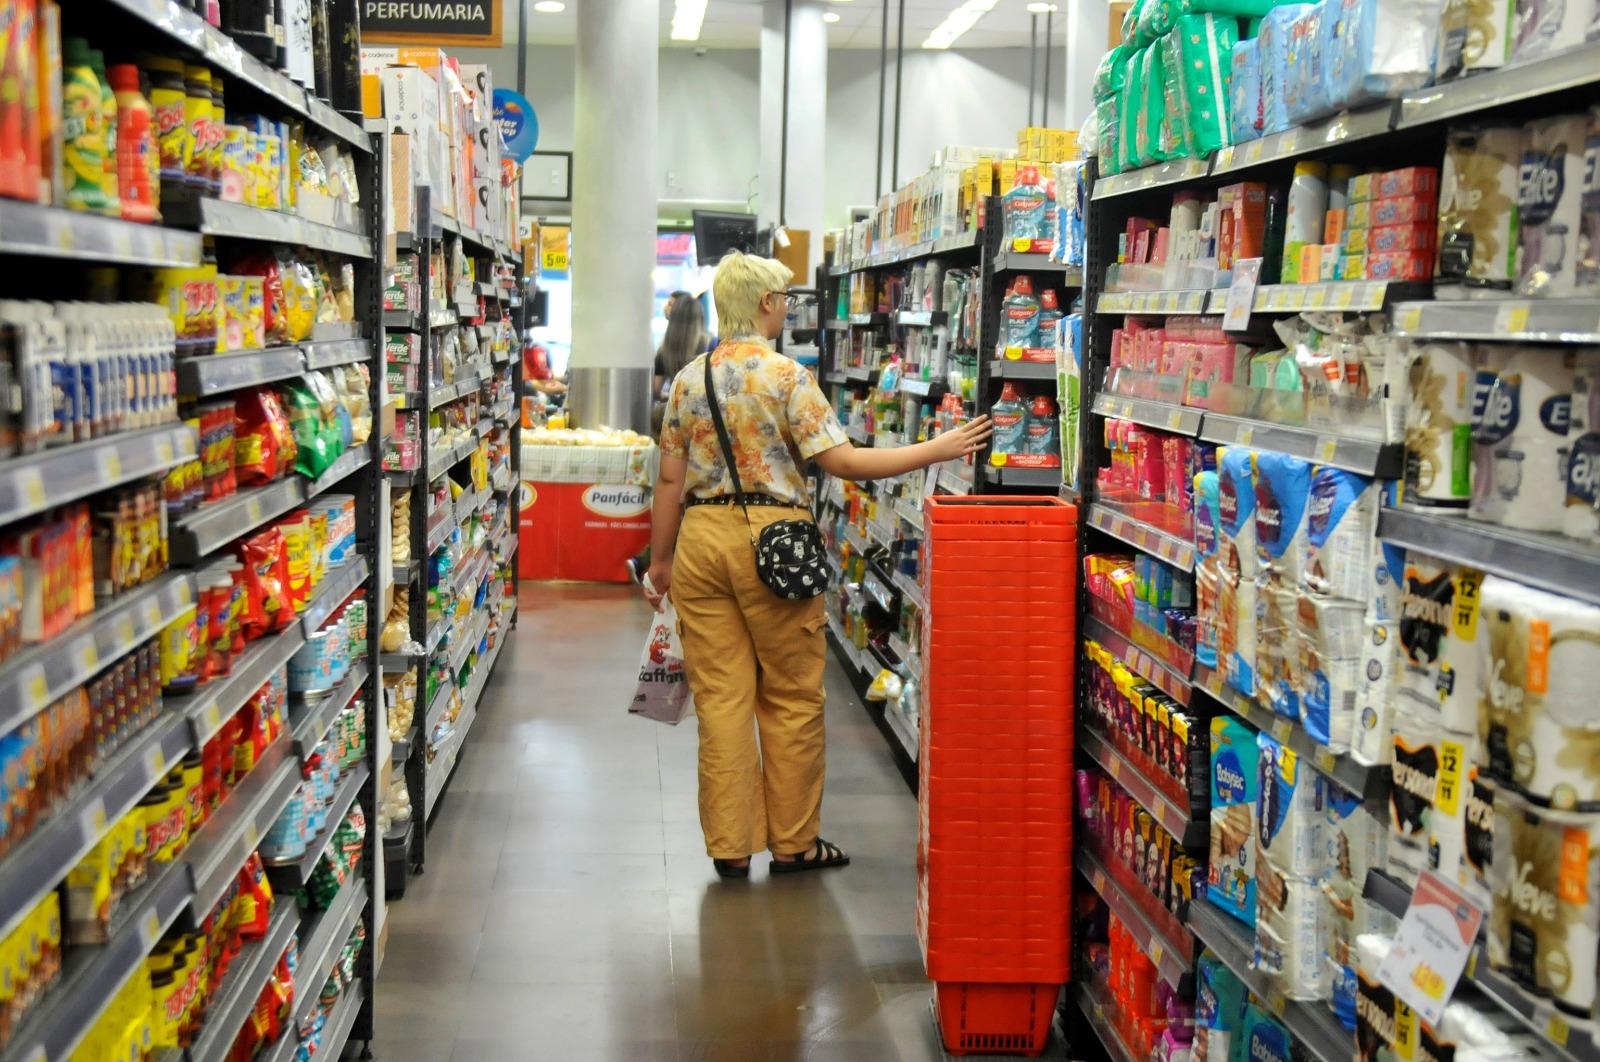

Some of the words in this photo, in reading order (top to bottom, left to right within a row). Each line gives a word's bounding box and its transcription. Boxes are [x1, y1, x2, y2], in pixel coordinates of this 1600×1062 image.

[366, 2, 486, 21] PERFUMARIA
[393, 263, 413, 273] erde
[385, 373, 405, 382] erde
[591, 491, 646, 506] Panfácil
[1460, 579, 1476, 598] 12
[1458, 613, 1470, 626] 11
[1443, 755, 1456, 772] 12
[1216, 762, 1245, 791] Babysec
[1442, 786, 1452, 800] 11
